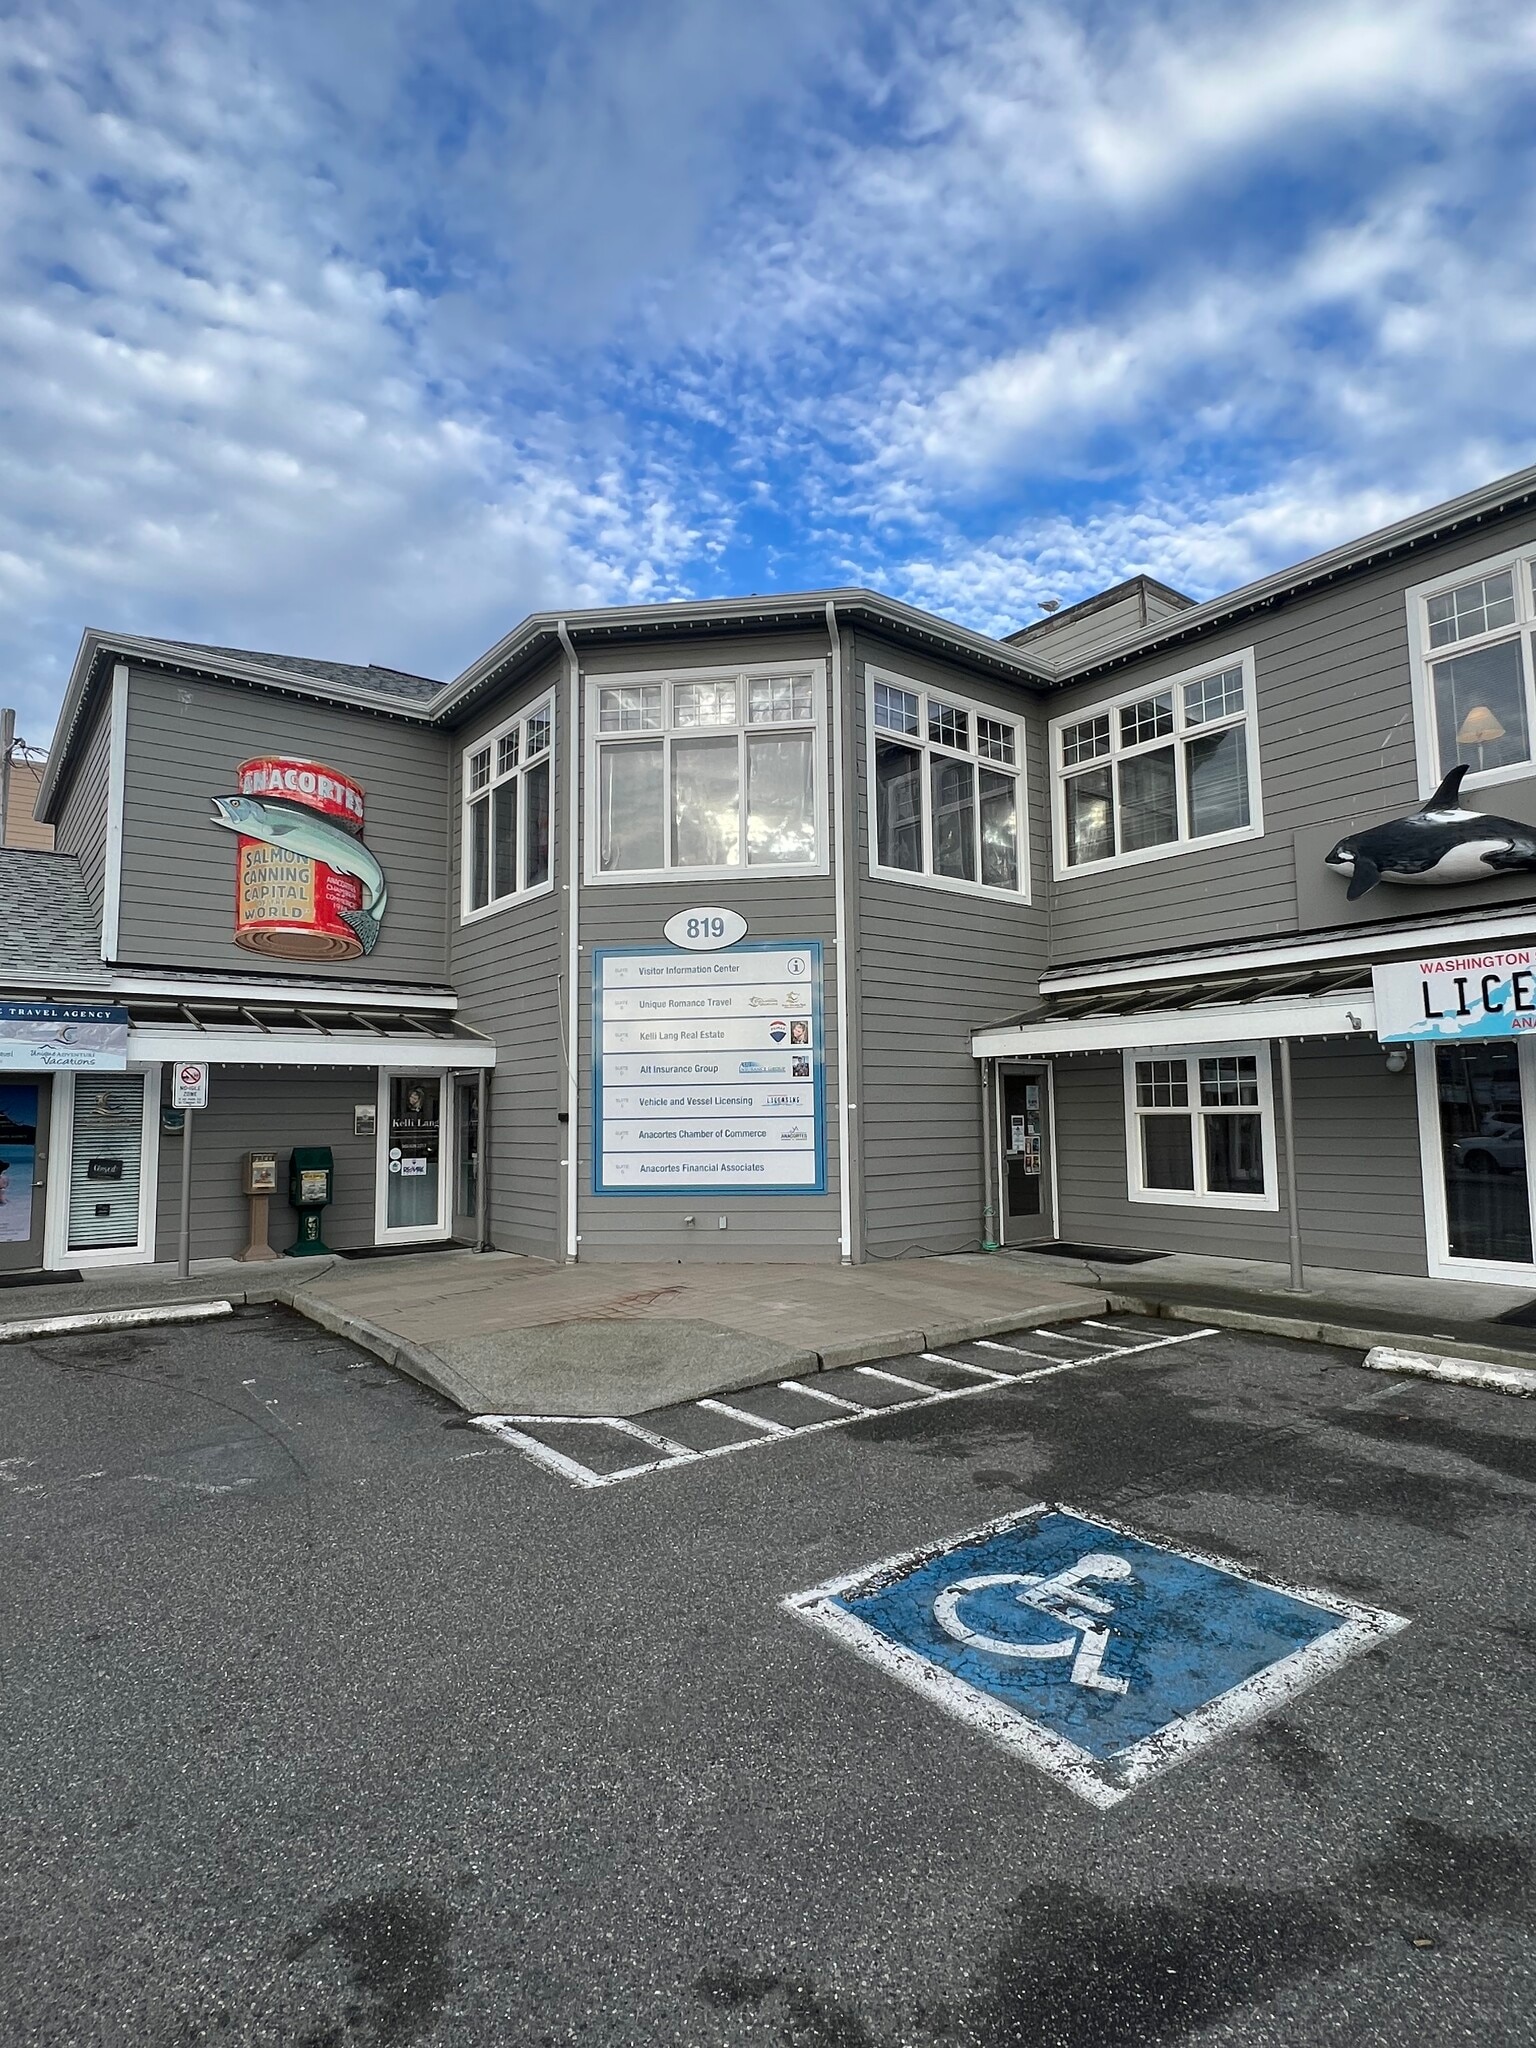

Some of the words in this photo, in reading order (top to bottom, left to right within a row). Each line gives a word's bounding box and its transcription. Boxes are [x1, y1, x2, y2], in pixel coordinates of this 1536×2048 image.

[243, 769, 363, 818] ANACORTES
[246, 849, 309, 868] SALMON
[244, 867, 310, 885] CANNING
[245, 886, 308, 901] CAPITAL
[245, 906, 303, 920] WORLD
[686, 917, 725, 939] 819
[1420, 952, 1530, 974] WASHINGTON
[638, 967, 664, 976] Visitor
[665, 965, 711, 975] Information
[713, 964, 740, 974] Center
[1422, 970, 1536, 1018] LICE
[639, 1000, 667, 1009] Unique
[668, 998, 706, 1008] Romance
[707, 998, 732, 1007] Travel
[9, 1008, 58, 1017] TRAVEL
[63, 1011, 112, 1019] AGENCY
[640, 1032, 657, 1041] Kelli
[659, 1032, 679, 1041] Lang
[680, 1031, 698, 1040] Real
[700, 1030, 725, 1039] Estate
[40, 1056, 96, 1066] Vacations
[653, 1065, 693, 1074] Insurance
[694, 1064, 719, 1074] Group
[639, 1098, 668, 1107] Vehicle
[669, 1098, 684, 1106] and
[686, 1097, 713, 1106] Vessel
[714, 1096, 753, 1107] Licensing
[392, 1118, 415, 1127] Kelli
[638, 1130, 677, 1139] Anacortes
[678, 1129, 714, 1139] Chamber
[715, 1129, 723, 1138] of
[724, 1129, 767, 1138] Commerce
[640, 1164, 680, 1173] Anacortes
[682, 1163, 719, 1173] Financial
[720, 1163, 765, 1172] Associates
